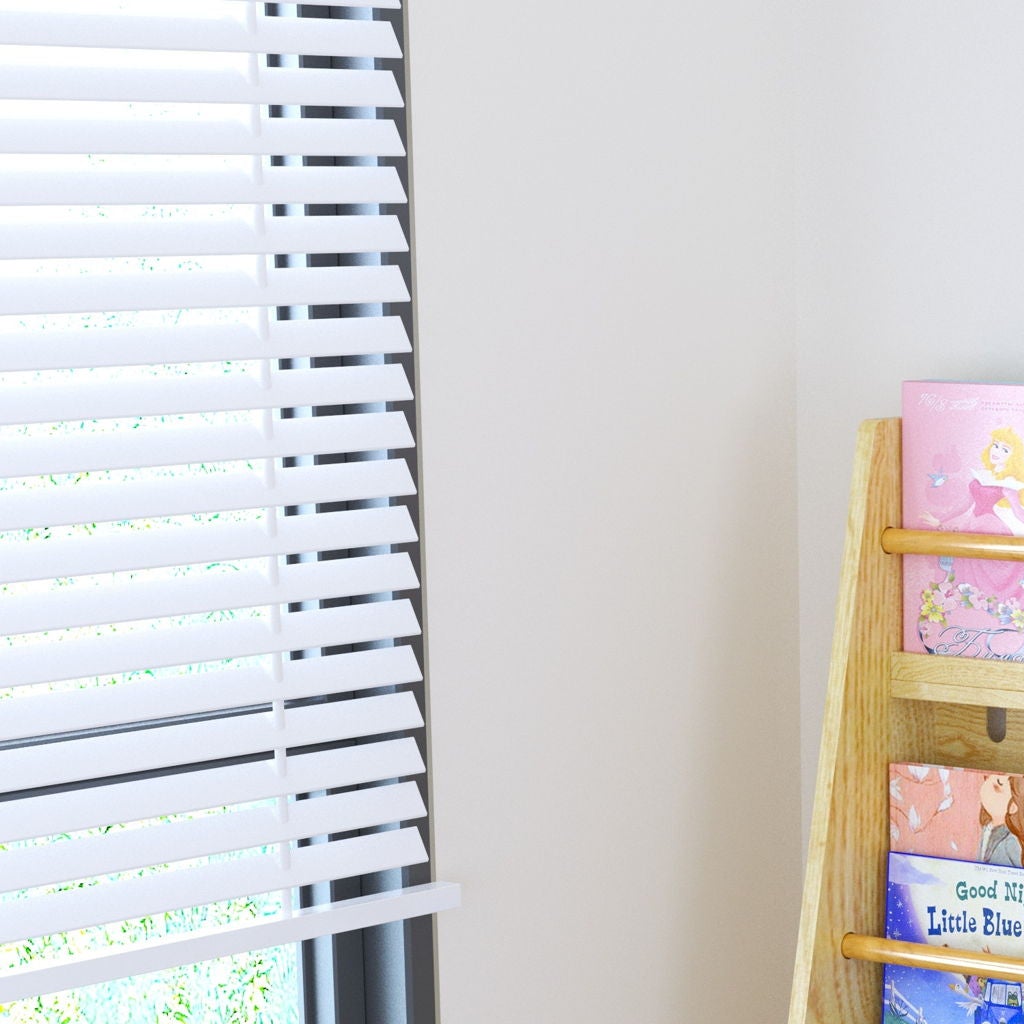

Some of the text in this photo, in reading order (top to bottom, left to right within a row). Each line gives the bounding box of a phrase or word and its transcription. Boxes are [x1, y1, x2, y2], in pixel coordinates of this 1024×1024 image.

[955, 880, 998, 901] Good
[927, 906, 977, 936] Little
[982, 907, 1022, 937] Blue
